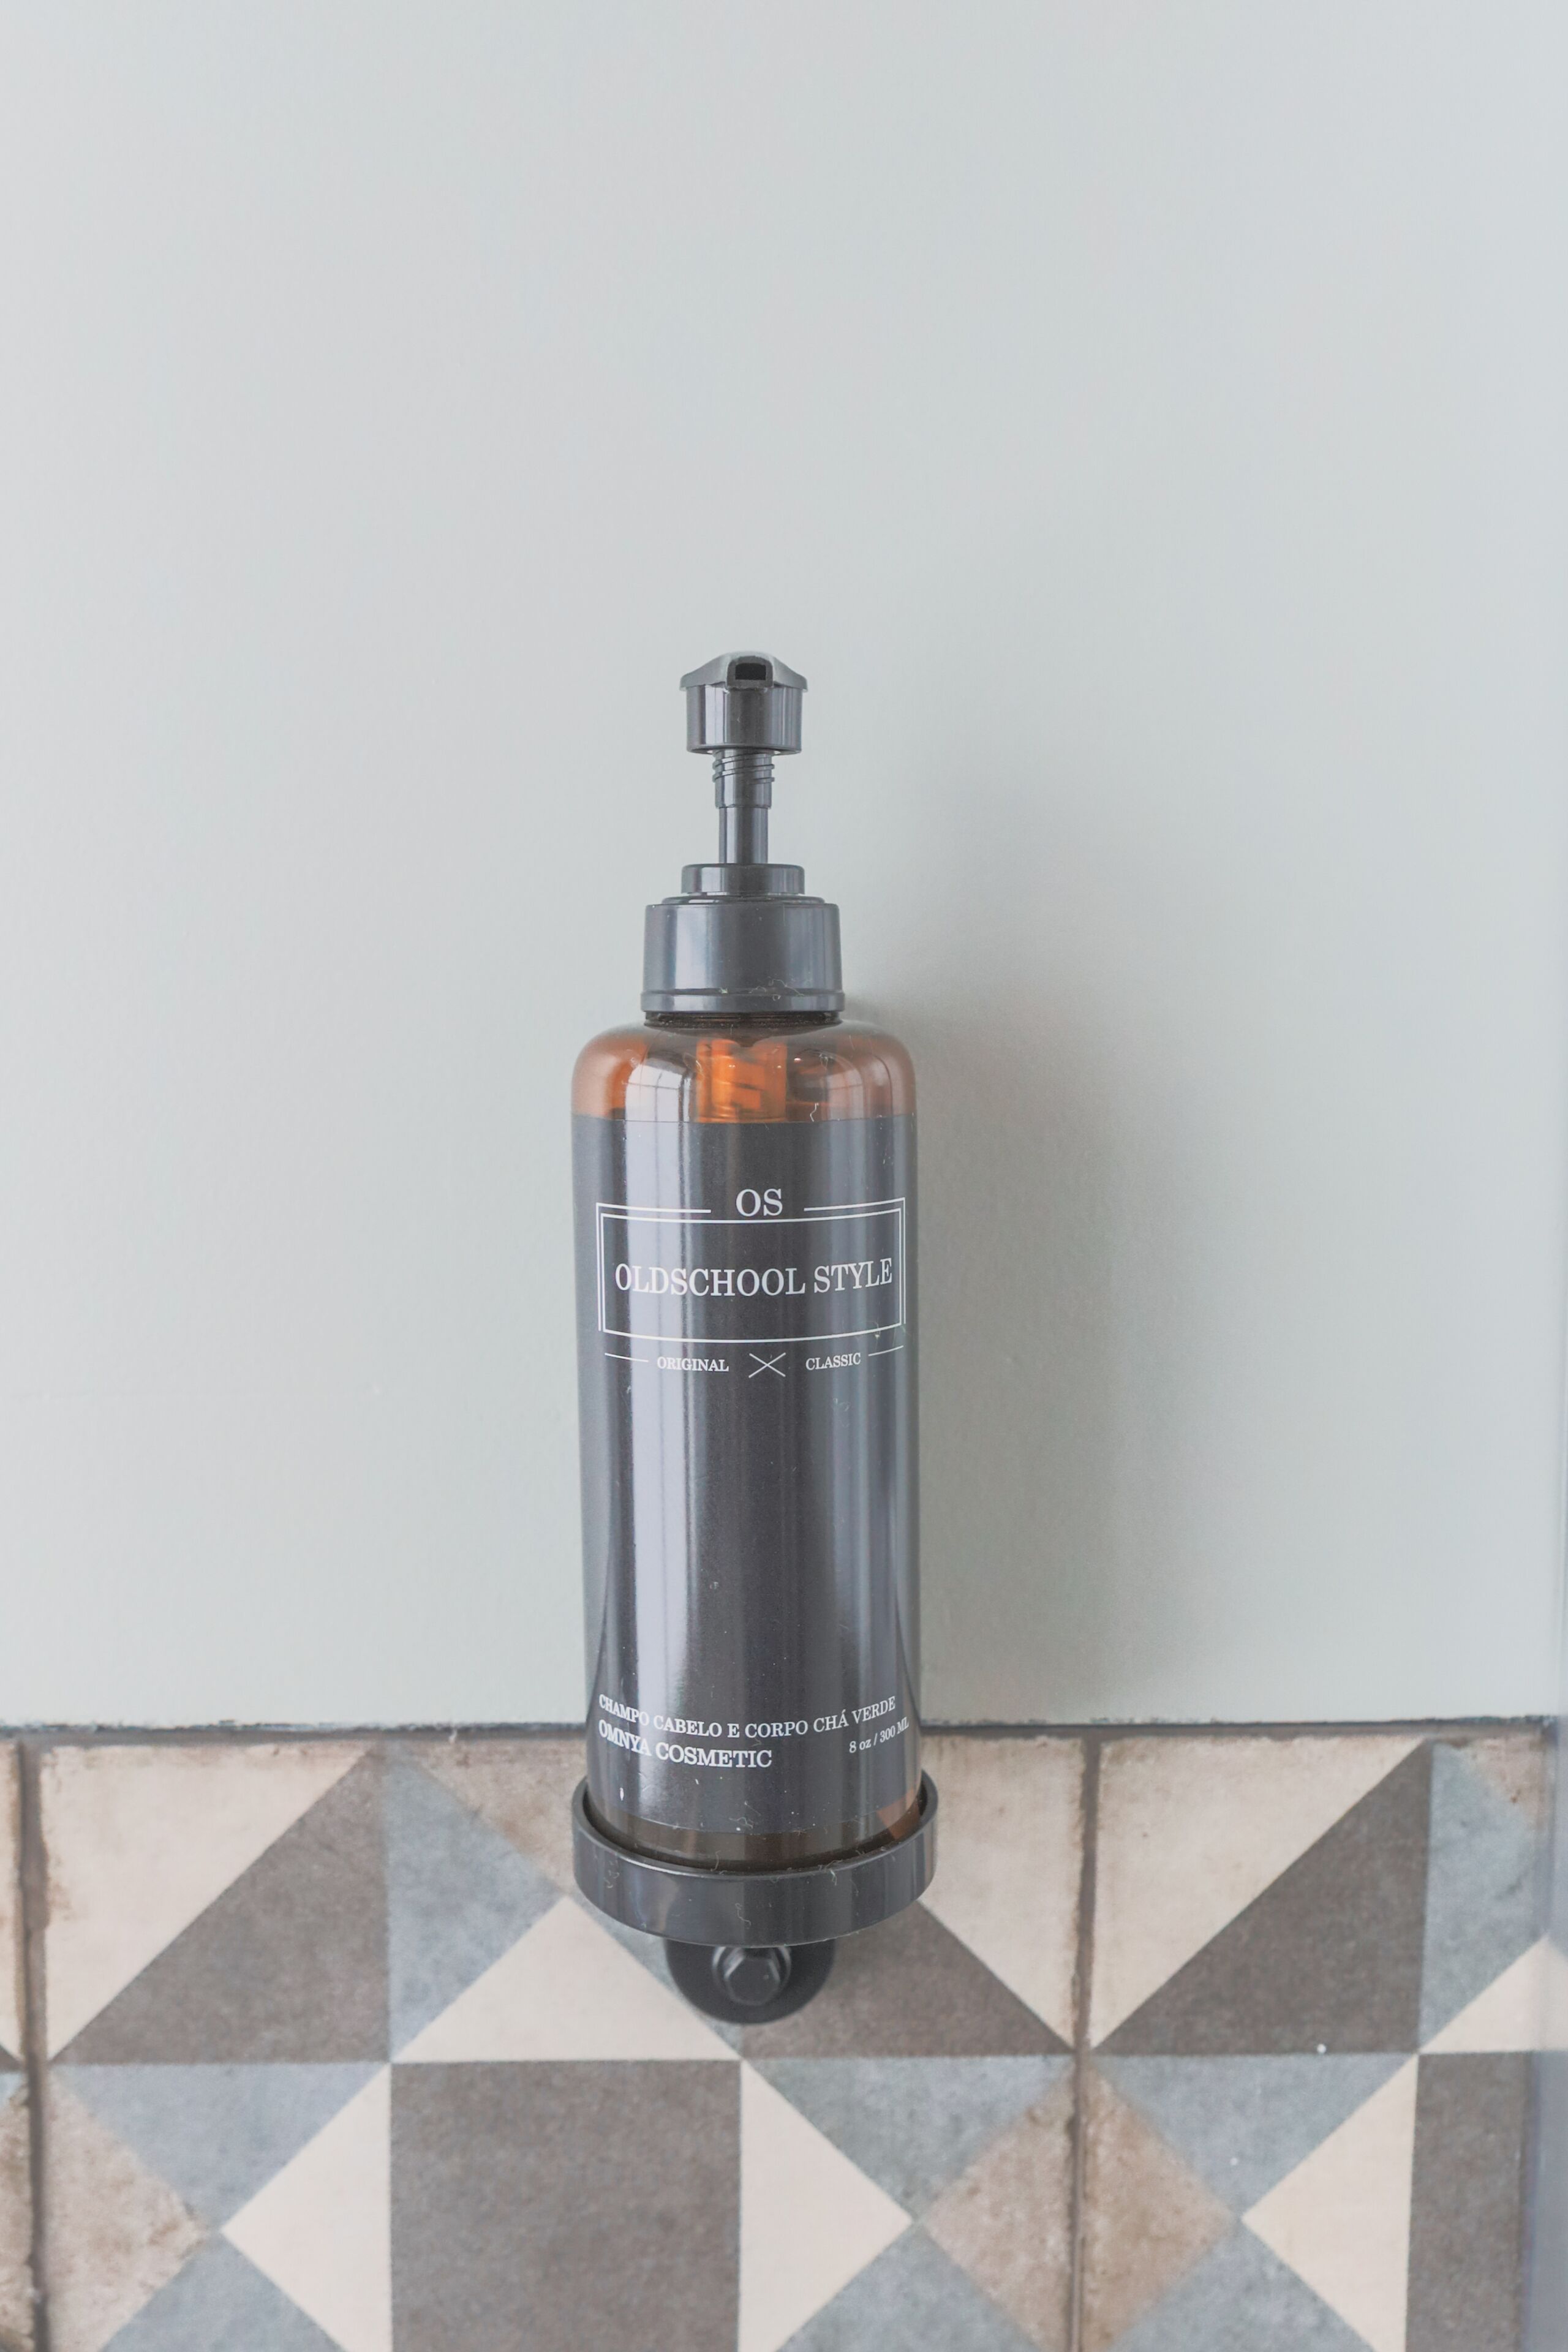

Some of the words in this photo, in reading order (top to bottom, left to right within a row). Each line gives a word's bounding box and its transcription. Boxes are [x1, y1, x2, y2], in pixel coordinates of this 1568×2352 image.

[736, 1188, 783, 1217] OS
[615, 1263, 805, 1297] OLDSCHOOL
[813, 1257, 893, 1293] STYLE
[657, 1356, 729, 1372] ORIGINAL
[805, 1352, 861, 1371] CLASSIC
[598, 1694, 650, 1726] CHAMPO
[653, 1714, 723, 1738] CABELO
[727, 1723, 740, 1738] E
[744, 1720, 809, 1738] CORPO
[813, 1709, 850, 1733] CHÁ
[851, 1695, 896, 1724] VERDE
[849, 1741, 856, 1753] 8
[859, 1739, 872, 1750] oz
[880, 1725, 896, 1743] 300
[897, 1717, 910, 1735] ML
[598, 1719, 652, 1757] OMNYA
[655, 1741, 772, 1768] COSMETIC
